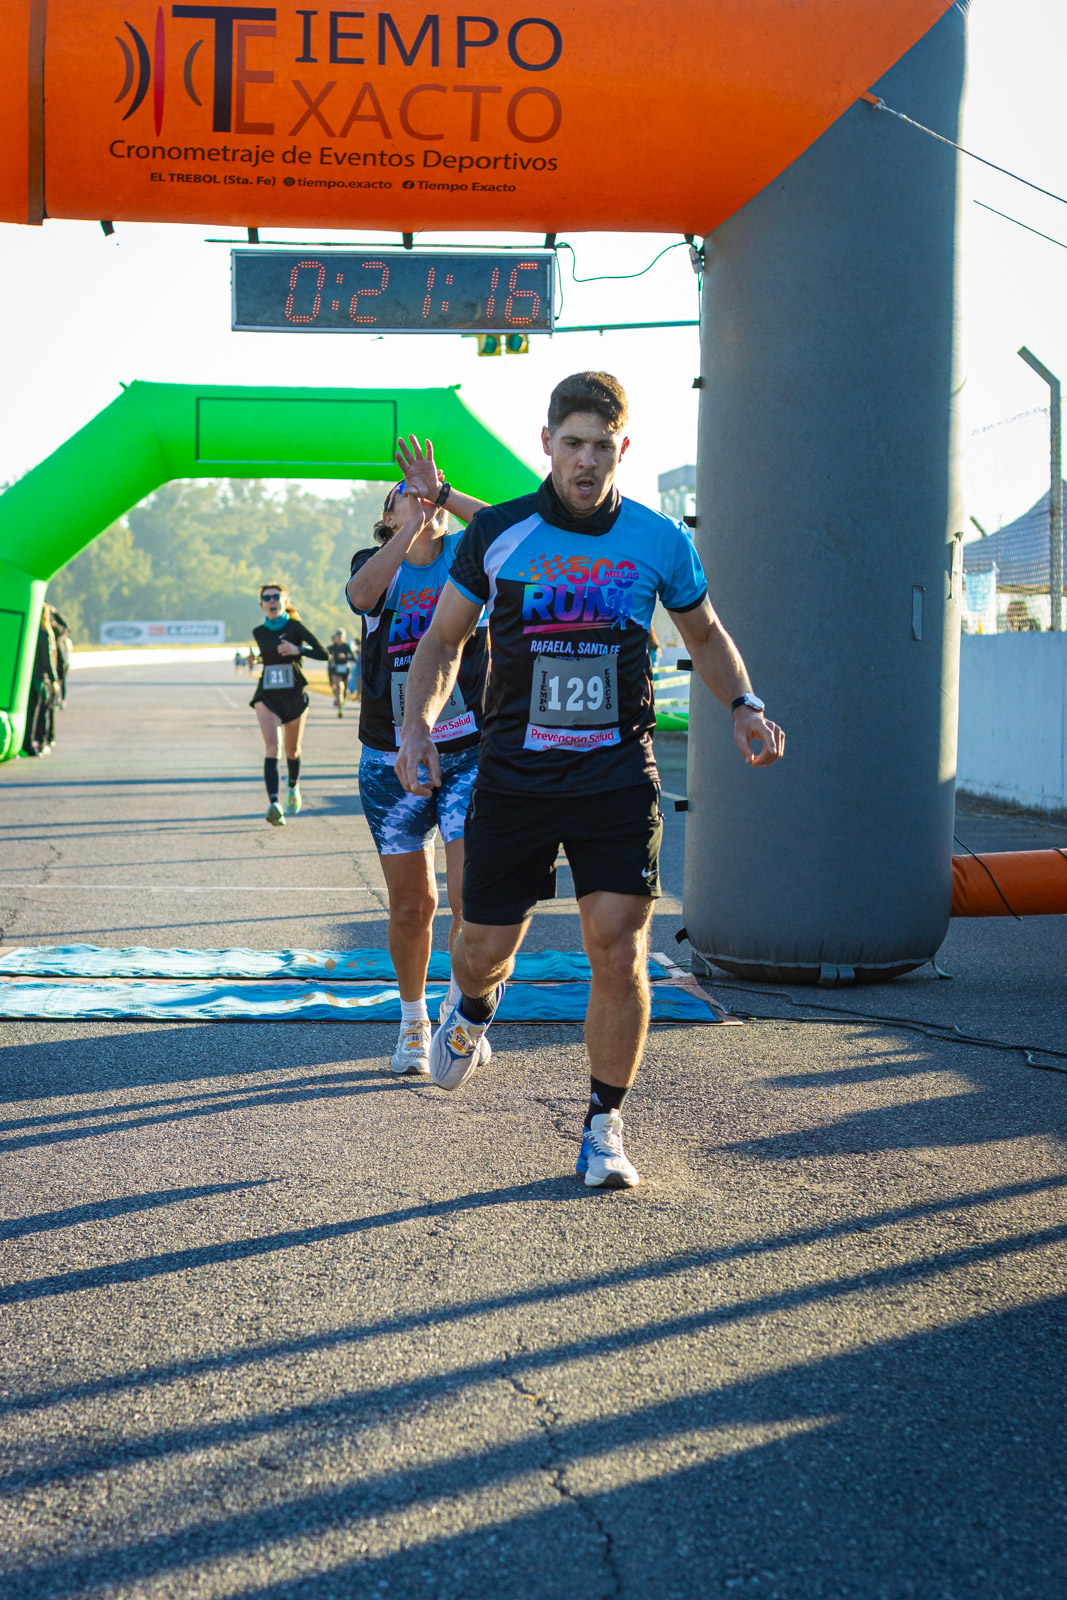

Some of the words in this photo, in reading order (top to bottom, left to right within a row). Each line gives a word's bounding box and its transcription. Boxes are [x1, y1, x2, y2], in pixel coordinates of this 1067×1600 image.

[109, 140, 275, 167] Cronometraje
[281, 145, 312, 164] de
[319, 147, 415, 167] Eventos
[423, 150, 558, 173] Deportivos
[150, 172, 166, 182] EL
[168, 173, 220, 184] TREBOL
[223, 175, 253, 186] (Sta.
[256, 176, 276, 187] Fe)
[298, 178, 392, 190] tiempo.exacto
[417, 180, 468, 192] Tiempo
[471, 182, 516, 192] Exacto
[604, 570, 639, 581] MILLAS
[522, 584, 621, 622] RUN
[388, 610, 432, 642] RU
[530, 640, 575, 655] RAFAELA,
[577, 642, 608, 656] SANTA
[271, 670, 284, 683] 21
[539, 670, 548, 713] TIEMPO
[547, 675, 604, 711] 129
[604, 668, 612, 710] EXACTO
[448, 714, 471, 730] Salud
[531, 728, 588, 744] Prevención
[589, 729, 615, 744] Salud
